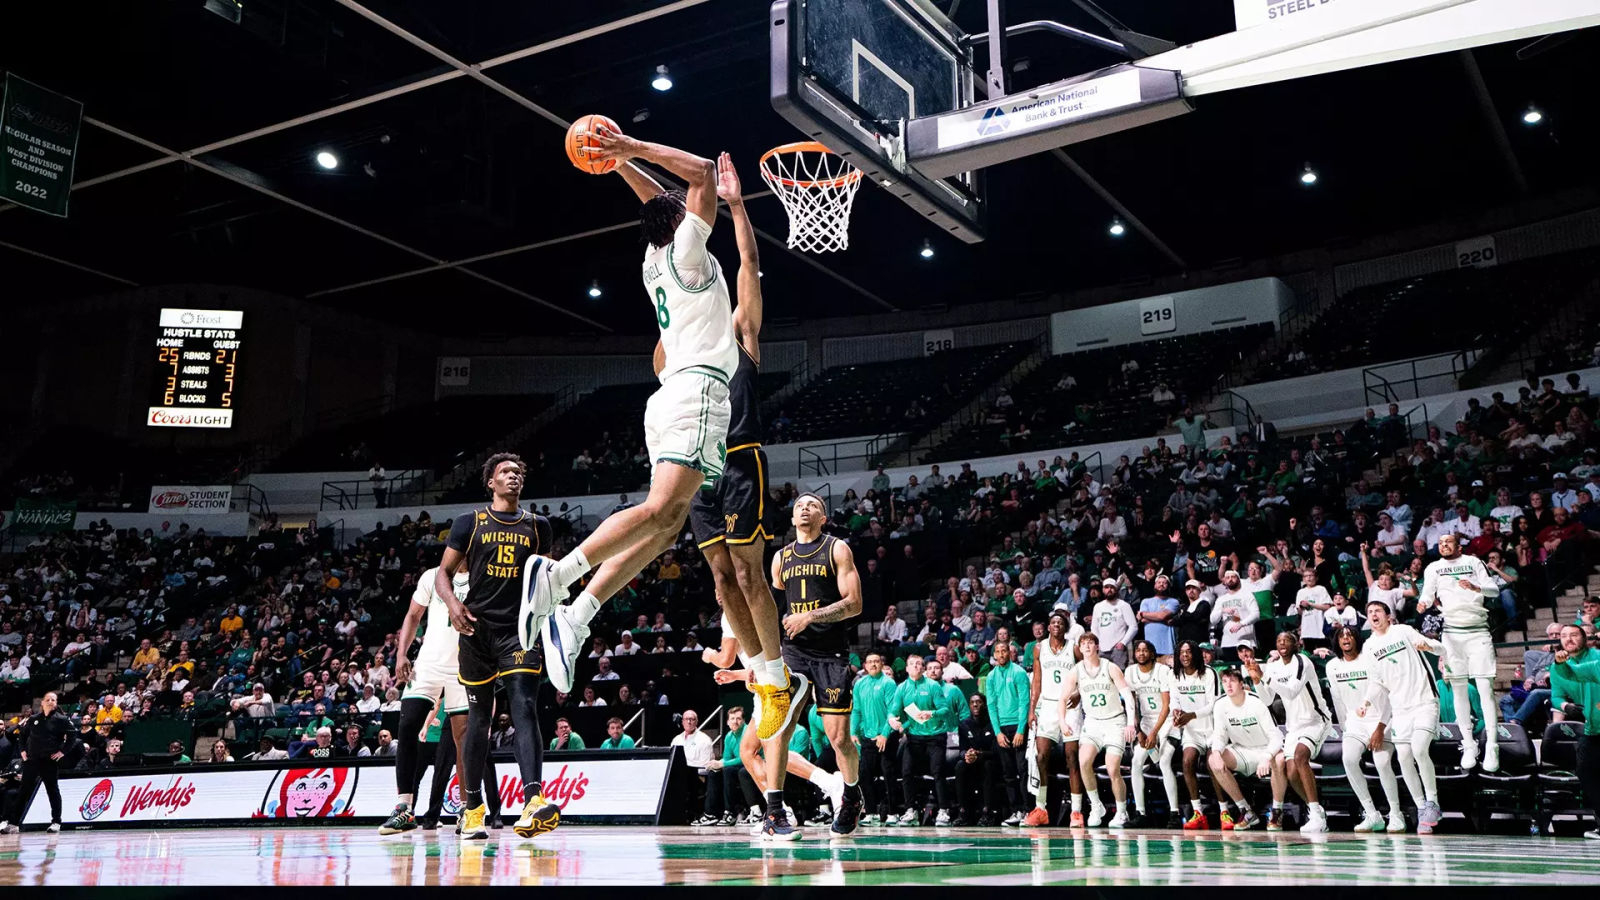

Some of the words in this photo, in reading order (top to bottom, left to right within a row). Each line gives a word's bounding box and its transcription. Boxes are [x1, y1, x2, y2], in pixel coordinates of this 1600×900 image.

[1268, 0, 1315, 19] STEEL
[1012, 98, 1055, 113] American
[1058, 86, 1098, 103] National
[1025, 111, 1048, 122] Bank
[1049, 108, 1057, 116] &
[1058, 102, 1083, 114] Trust
[5, 125, 41, 146] REGULAR
[42, 140, 72, 156] SEASON
[7, 146, 28, 160] WEST
[29, 154, 64, 172] DIVISION
[28, 145, 45, 157] AND
[11, 158, 58, 180] CHAMPIONS
[15, 180, 48, 199] 2022
[1459, 247, 1494, 266] 220
[656, 286, 670, 329] 8
[197, 314, 222, 324] Frost
[1143, 308, 1172, 324] 219
[163, 328, 203, 338] HUSTLE
[204, 330, 236, 339] STATS
[156, 338, 184, 347] HOME
[213, 341, 240, 349] GUEST
[926, 340, 951, 351] 218
[159, 348, 179, 361] 25
[183, 352, 211, 360] RBNDS
[216, 350, 236, 363] 21
[169, 362, 178, 376] 7
[182, 366, 210, 375] ASSISTS
[225, 364, 235, 378] 3
[443, 366, 468, 377] 216
[166, 377, 176, 391] 3
[180, 380, 208, 389] STEALS
[224, 379, 233, 392] 7
[164, 391, 174, 405] 6
[179, 395, 207, 404] BLOCKS
[221, 393, 231, 407] 5
[151, 410, 192, 424] Coors
[193, 415, 228, 425] LIGHT
[190, 491, 230, 500] STUDENT
[188, 500, 225, 509] SECTION
[16, 511, 71, 524] MANIACS
[481, 531, 530, 548] WICHITA
[497, 544, 515, 564] 15
[487, 564, 519, 578] STATE
[782, 564, 827, 582] WICHITA
[801, 578, 806, 599] 1
[1373, 648, 1387, 657] MEAN
[1387, 640, 1405, 651] GREEN
[1053, 670, 1061, 683] 6
[1090, 694, 1107, 707] 23
[1147, 697, 1157, 710] 5
[313, 748, 329, 757] POSS
[499, 765, 589, 810] Wedy's
[120, 776, 195, 818] Wendy's
